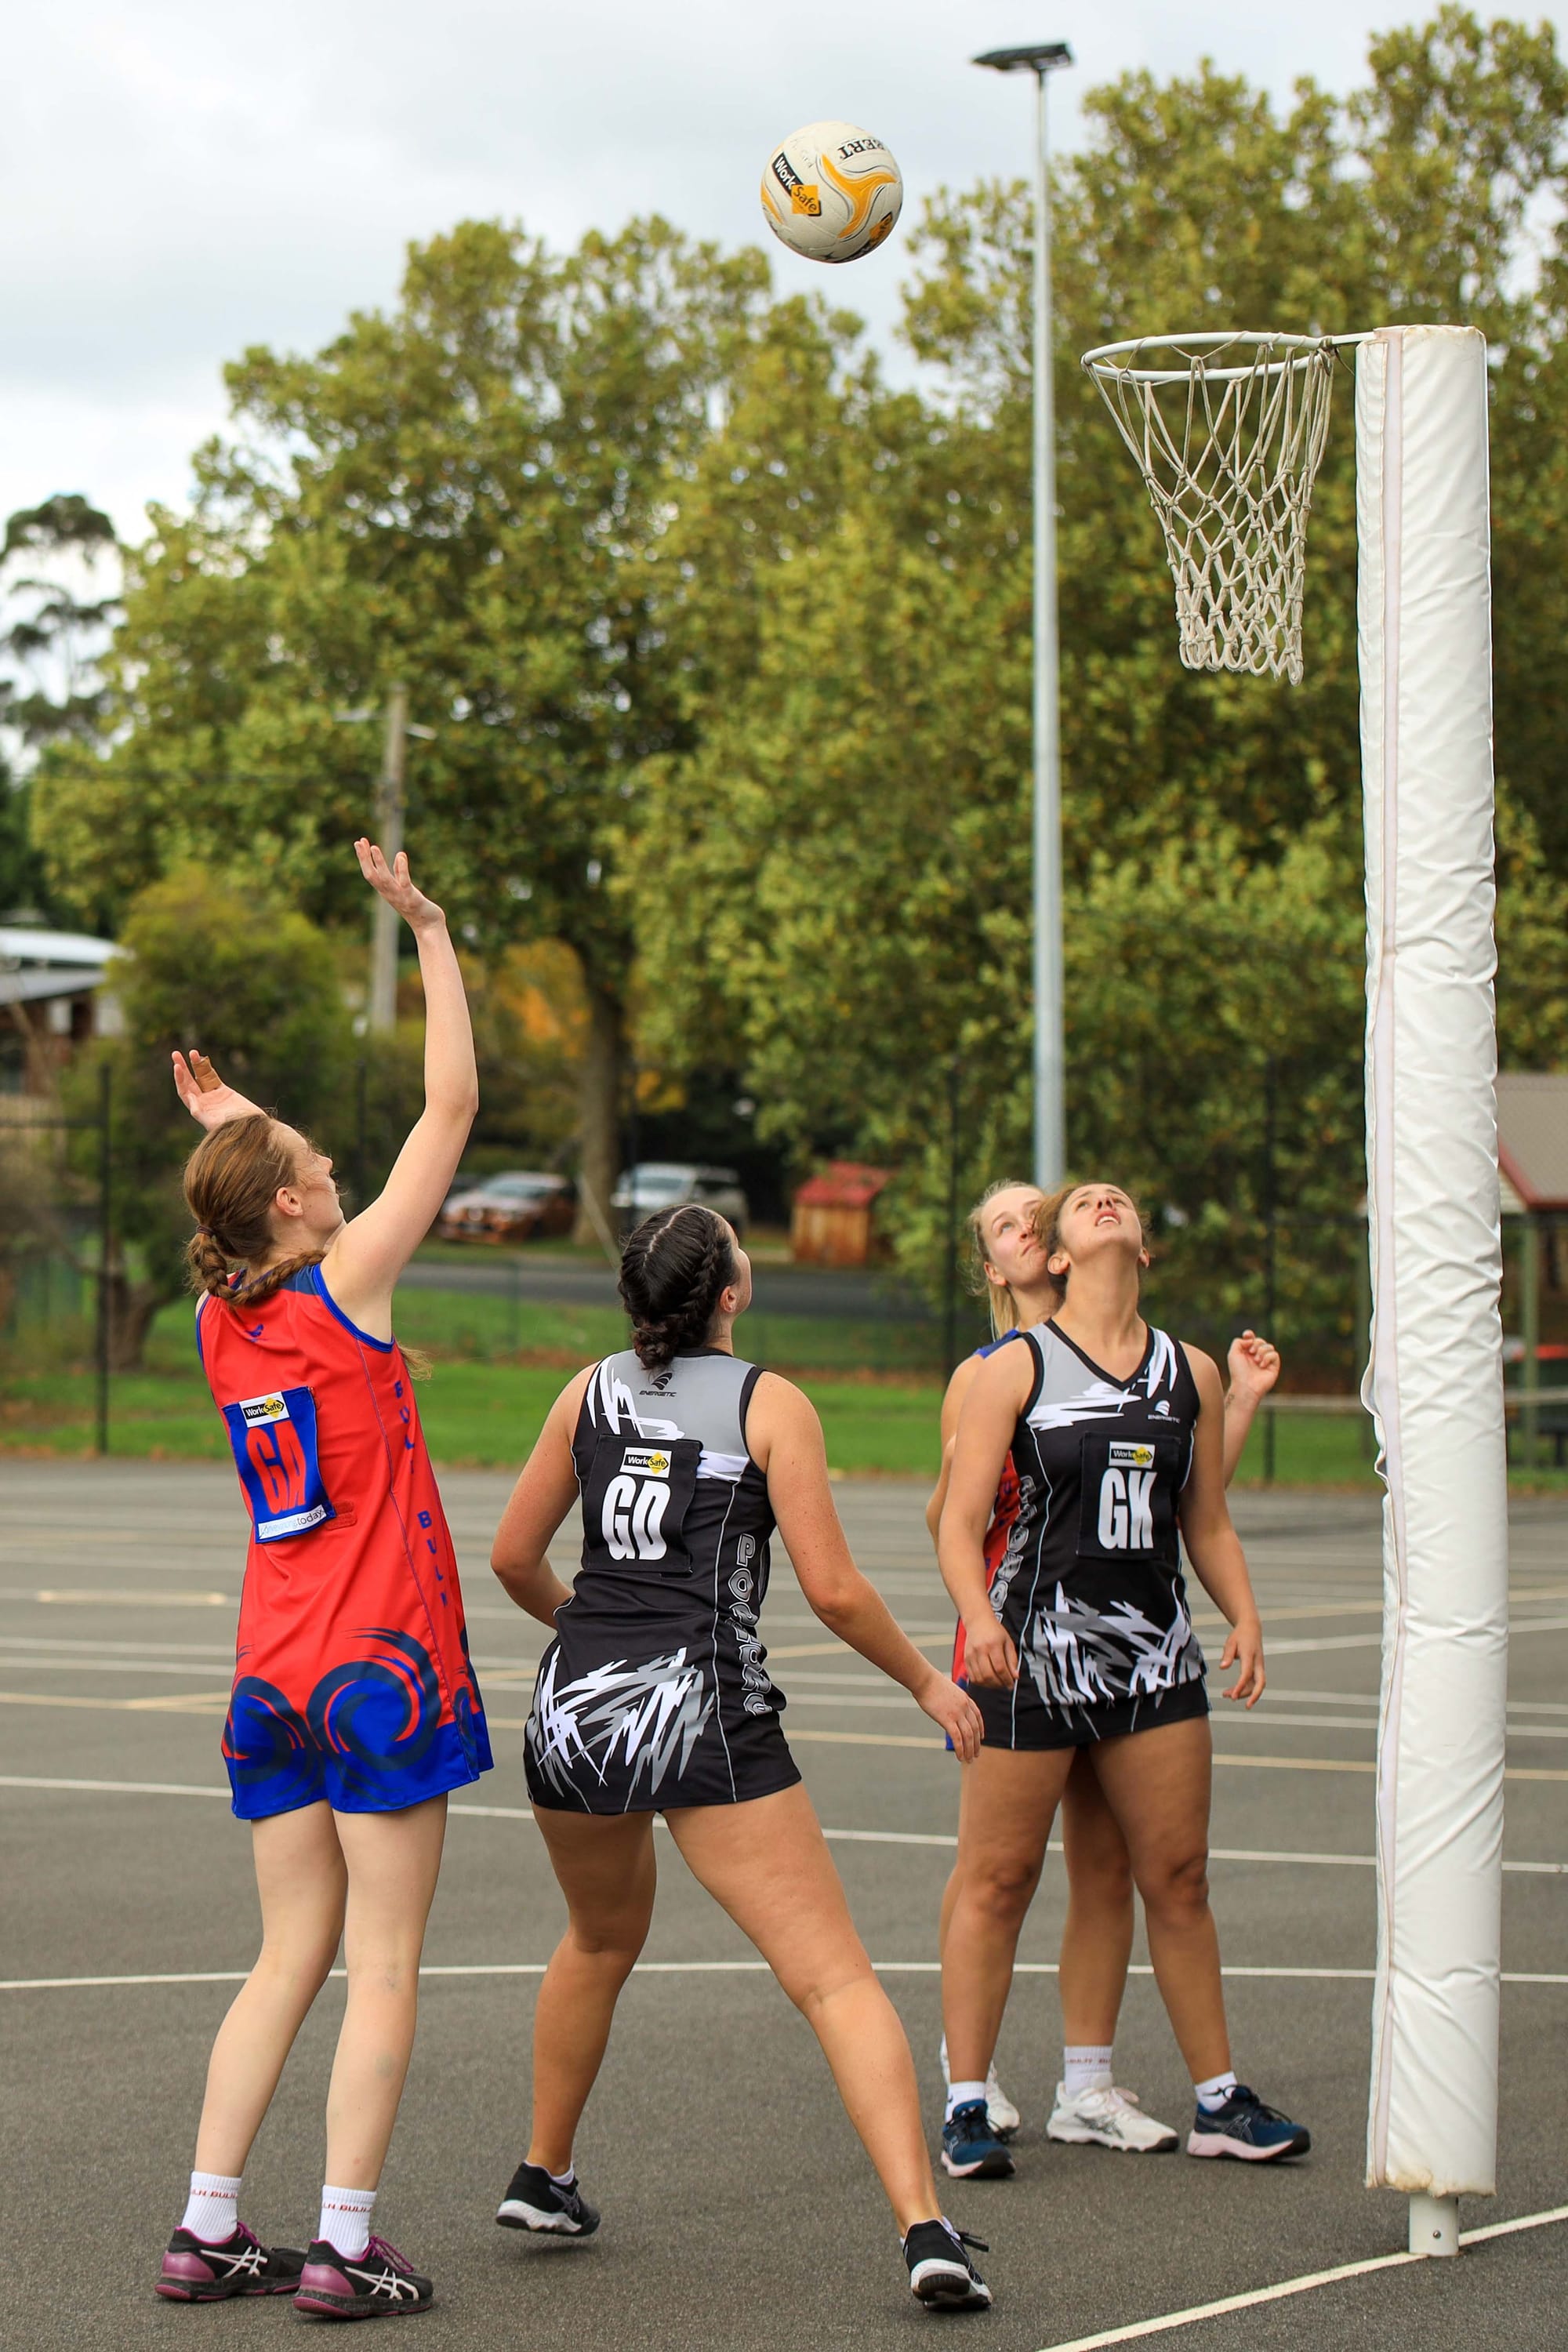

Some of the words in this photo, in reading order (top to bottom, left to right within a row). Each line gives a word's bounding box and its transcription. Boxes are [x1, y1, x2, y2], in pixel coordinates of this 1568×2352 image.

[245, 1420, 307, 1515] GA
[1098, 1468, 1158, 1549] GK
[601, 1475, 671, 1561] GD
